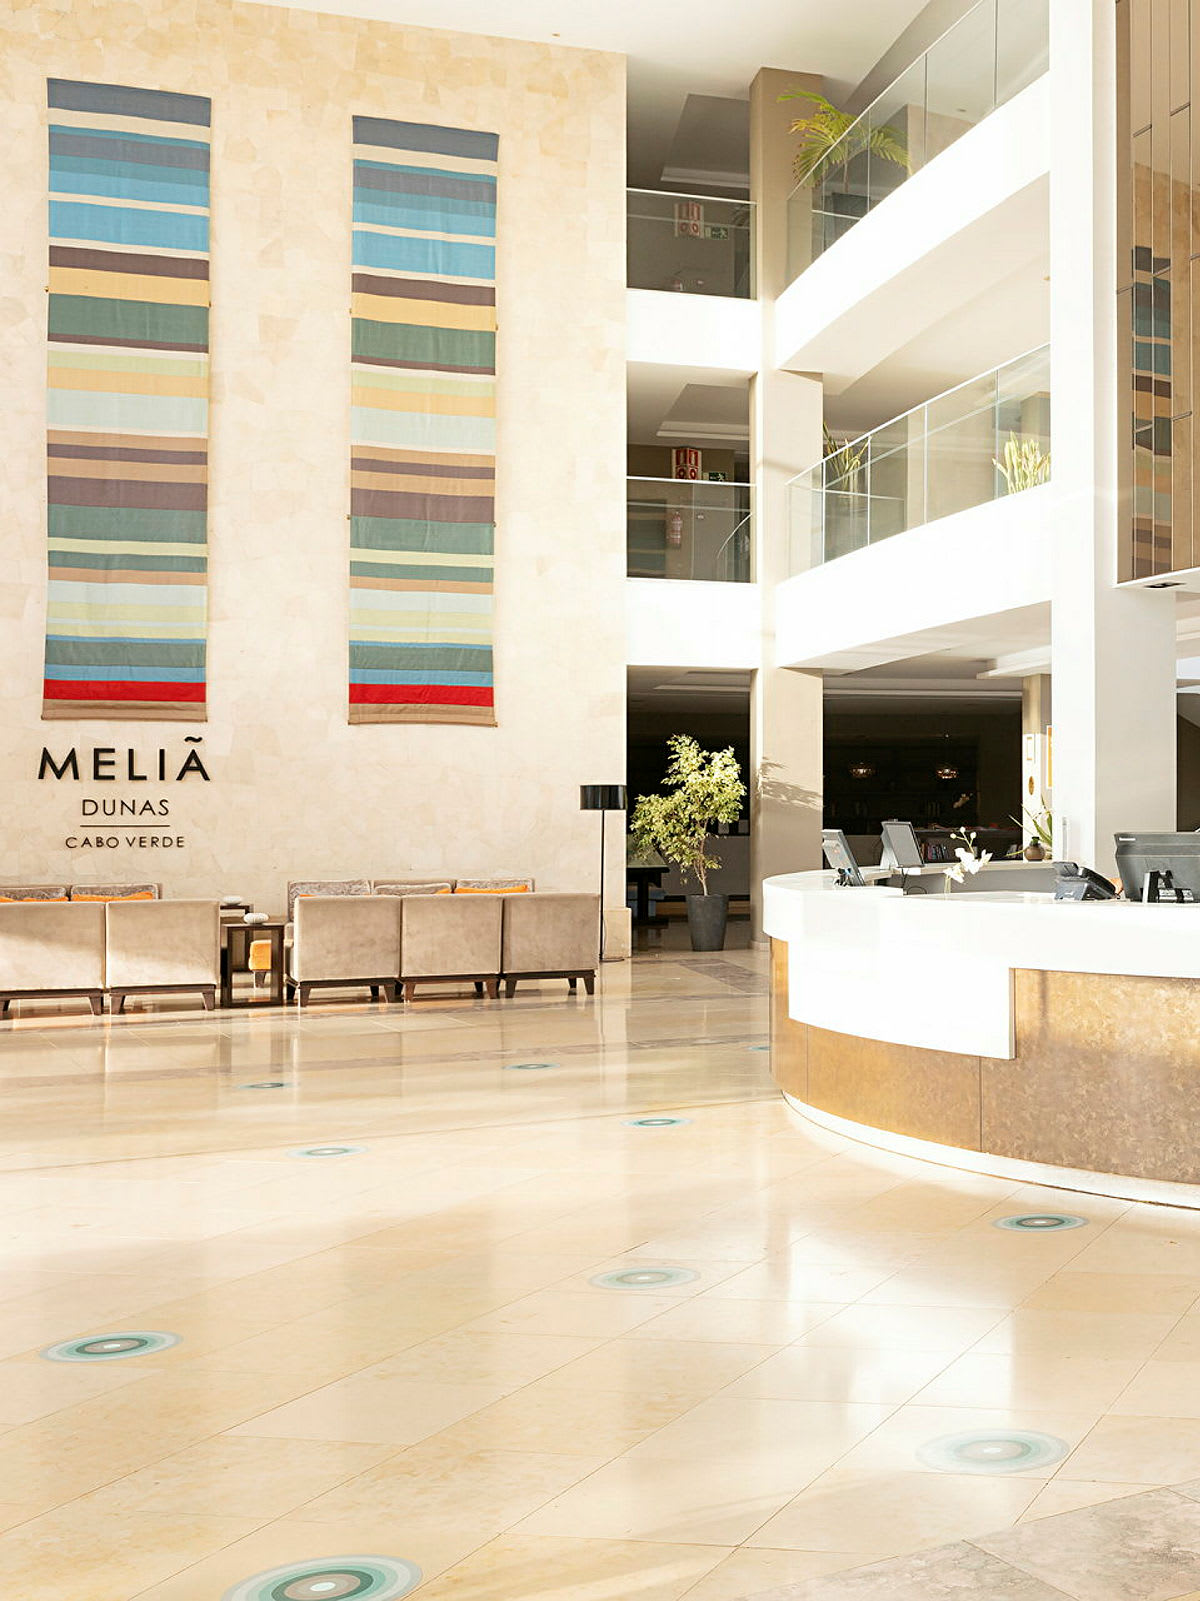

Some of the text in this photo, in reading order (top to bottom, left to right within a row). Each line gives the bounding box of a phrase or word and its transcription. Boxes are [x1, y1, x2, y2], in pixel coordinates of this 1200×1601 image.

[82, 799, 170, 816] DUNAS
[65, 836, 185, 849] CABO VERDE
